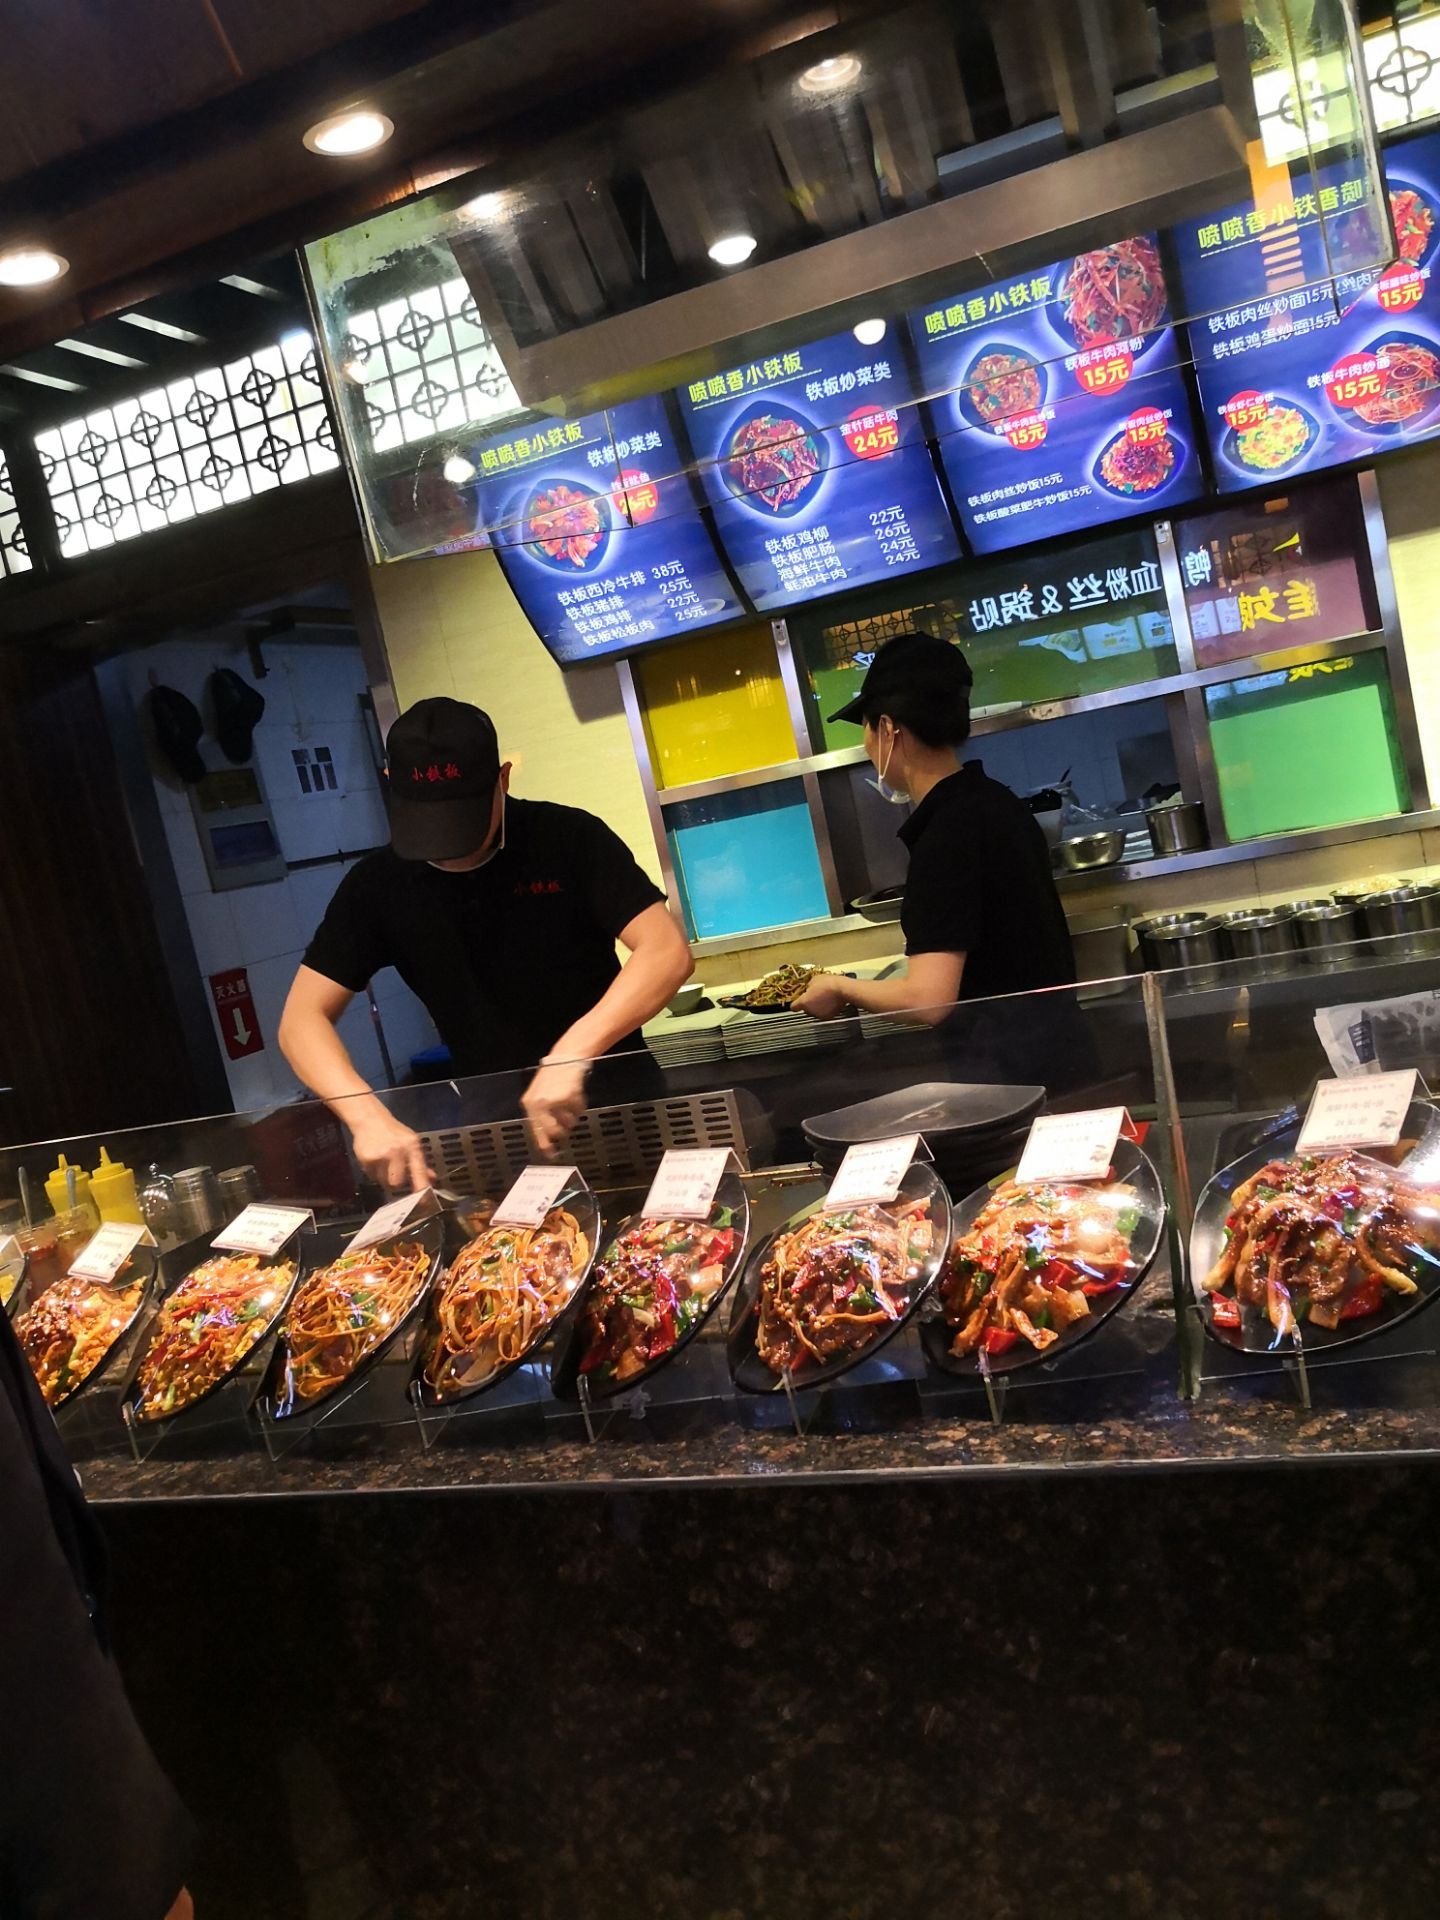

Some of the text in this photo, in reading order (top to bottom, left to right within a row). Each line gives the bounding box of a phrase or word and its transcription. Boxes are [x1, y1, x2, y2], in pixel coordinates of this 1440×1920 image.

[924, 275, 1053, 335] 喷喷香小铁板
[1381, 281, 1423, 308] 15元
[1064, 337, 1145, 372] 铁板牛肉河粉
[1306, 355, 1391, 390] 铁板牛肉炒面
[688, 351, 804, 403] 喷喷香小铁板
[805, 361, 892, 402] 铁板炒菜类
[1083, 358, 1129, 388] 15元
[1333, 374, 1381, 401] 15元
[839, 408, 899, 436] 金针菇牛肉
[1009, 423, 1047, 444] 15元
[1129, 421, 1167, 443] 15元
[1228, 404, 1267, 427] 15元
[480, 421, 584, 469] 喷喷香小铁板
[586, 430, 663, 468] 铁板炒菜类
[853, 425, 899, 453] 24元
[764, 504, 905, 555] 铁板鸡柳 22元
[770, 520, 911, 569] 铁板肥肠 26元
[777, 535, 916, 582] 海鲜牛肉 24元
[885, 548, 921, 566] 24元
[556, 560, 685, 606] 铁板西冷牛排 38元
[565, 576, 693, 621] 铁板猪排 25元
[574, 591, 700, 634] 铁板鸡排 22元
[582, 605, 708, 647] 铁板松板肉 25元
[215, 979, 247, 1000] 灭火器
